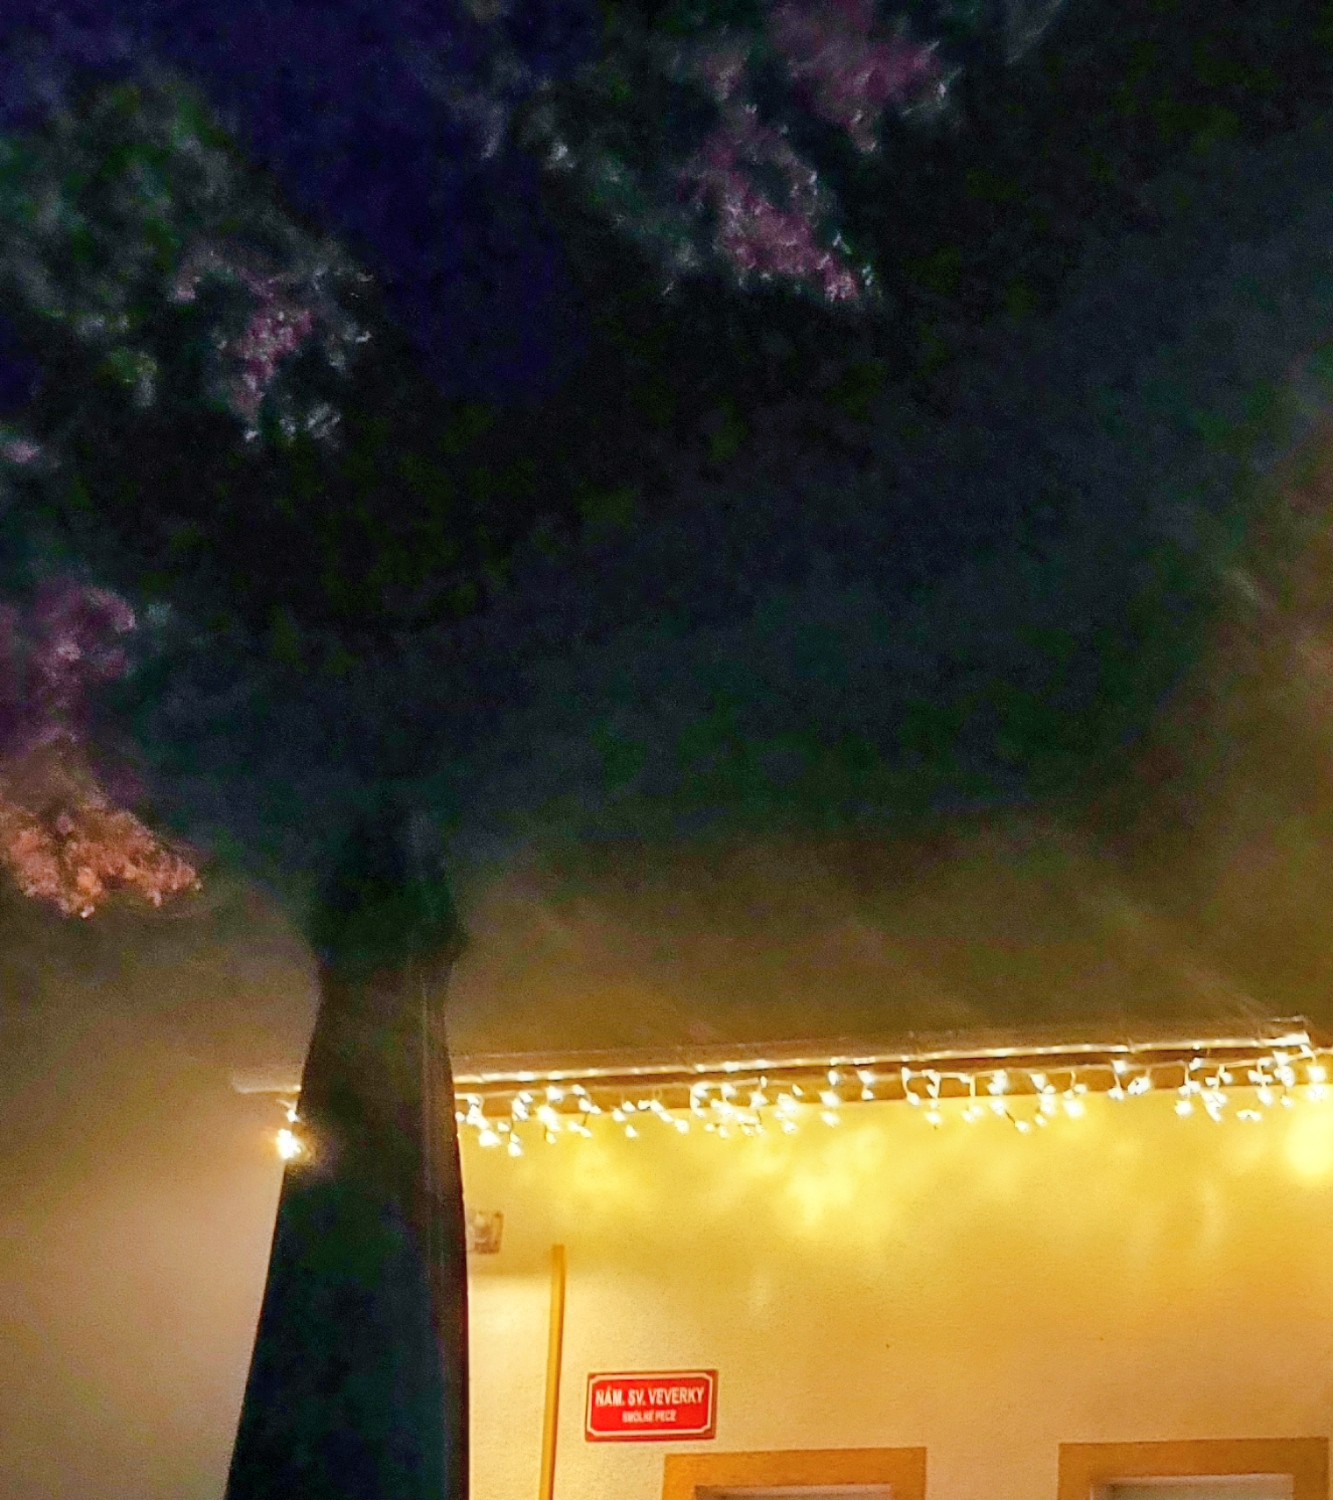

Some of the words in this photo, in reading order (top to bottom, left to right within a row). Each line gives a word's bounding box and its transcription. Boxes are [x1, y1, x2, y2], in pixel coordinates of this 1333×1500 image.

[595, 1385, 625, 1407] NÁM.
[628, 1388, 646, 1406] SV.
[647, 1386, 704, 1406] VEVERKY
